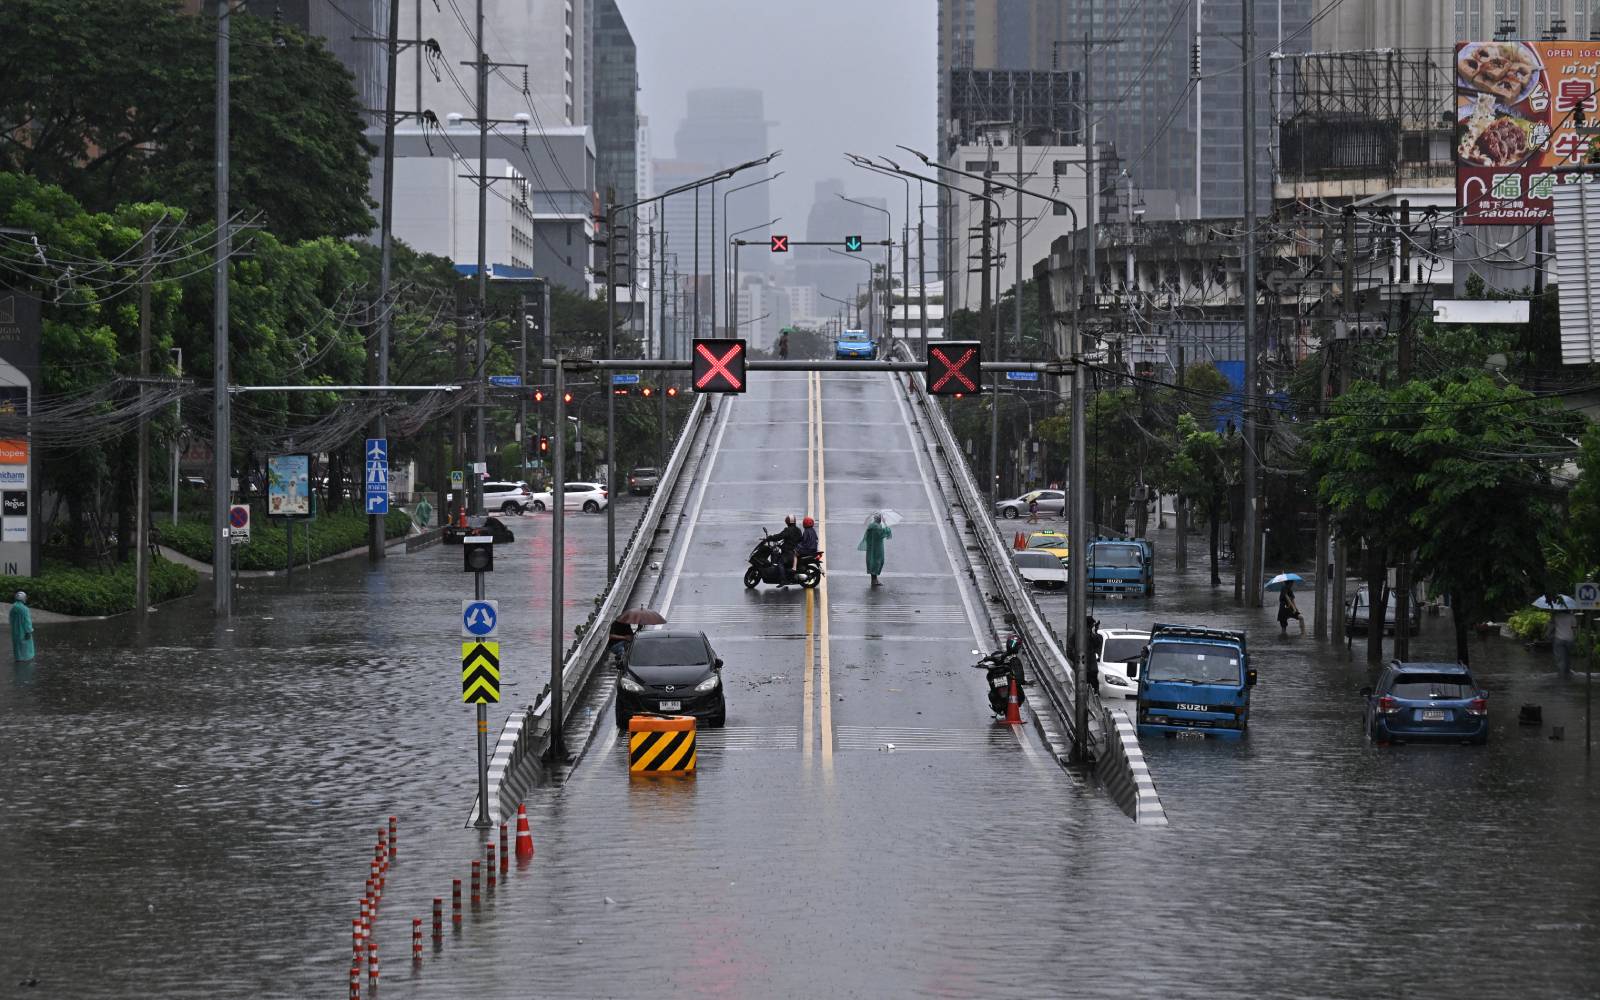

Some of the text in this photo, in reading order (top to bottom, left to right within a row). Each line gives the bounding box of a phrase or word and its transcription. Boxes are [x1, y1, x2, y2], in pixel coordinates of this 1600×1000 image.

[1547, 49, 1573, 57] OPEN
[4, 499, 25, 509] Regus
[4, 562, 18, 575] IN
[1176, 703, 1208, 712] ISUZU
